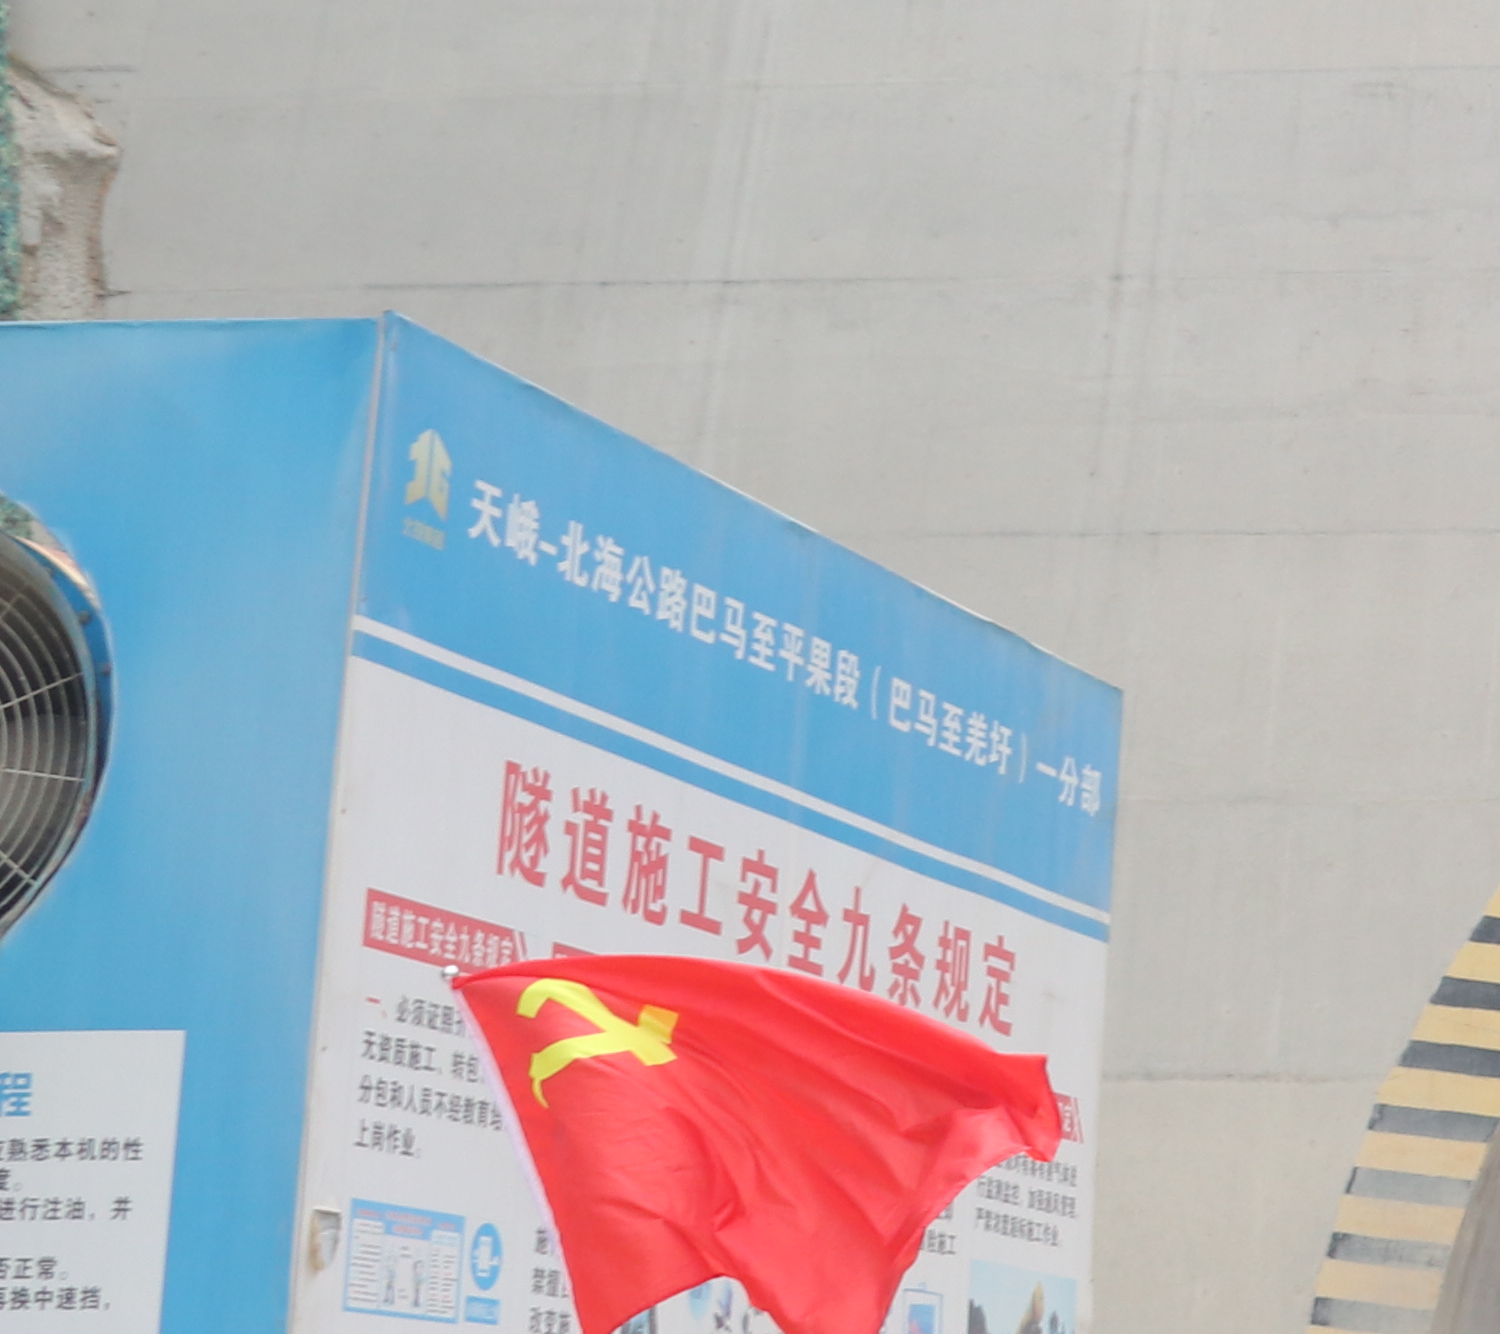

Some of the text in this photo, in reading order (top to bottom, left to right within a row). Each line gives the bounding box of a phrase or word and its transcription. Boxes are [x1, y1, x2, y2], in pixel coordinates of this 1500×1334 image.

[496, 760, 1017, 1036] 隧道施工安全九条规定
[0, 1287, 111, 1311] 换中速挡，
